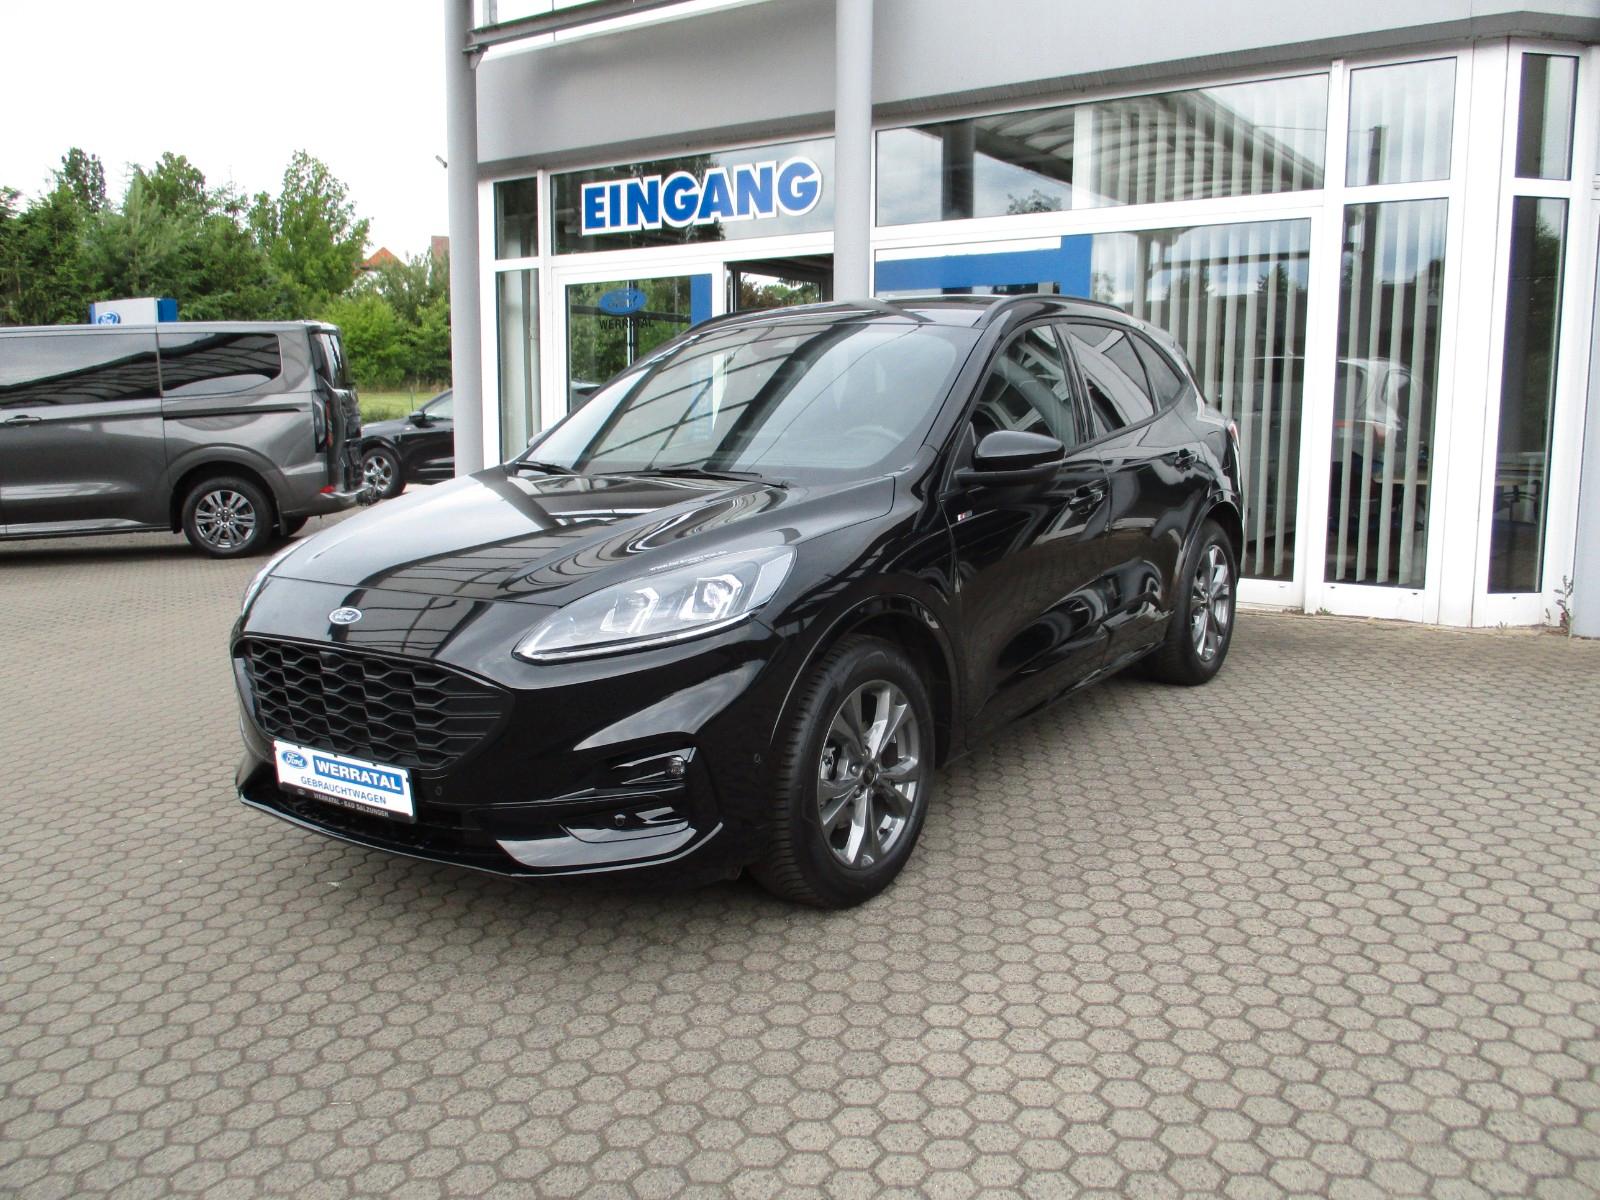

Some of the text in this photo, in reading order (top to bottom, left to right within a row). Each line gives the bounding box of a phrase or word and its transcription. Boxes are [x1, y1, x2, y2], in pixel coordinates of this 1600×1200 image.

[582, 157, 821, 235] EINGANG
[286, 752, 401, 791] Ford WERRATAL
[300, 776, 387, 805] GEBRAUCHTWAGEN
